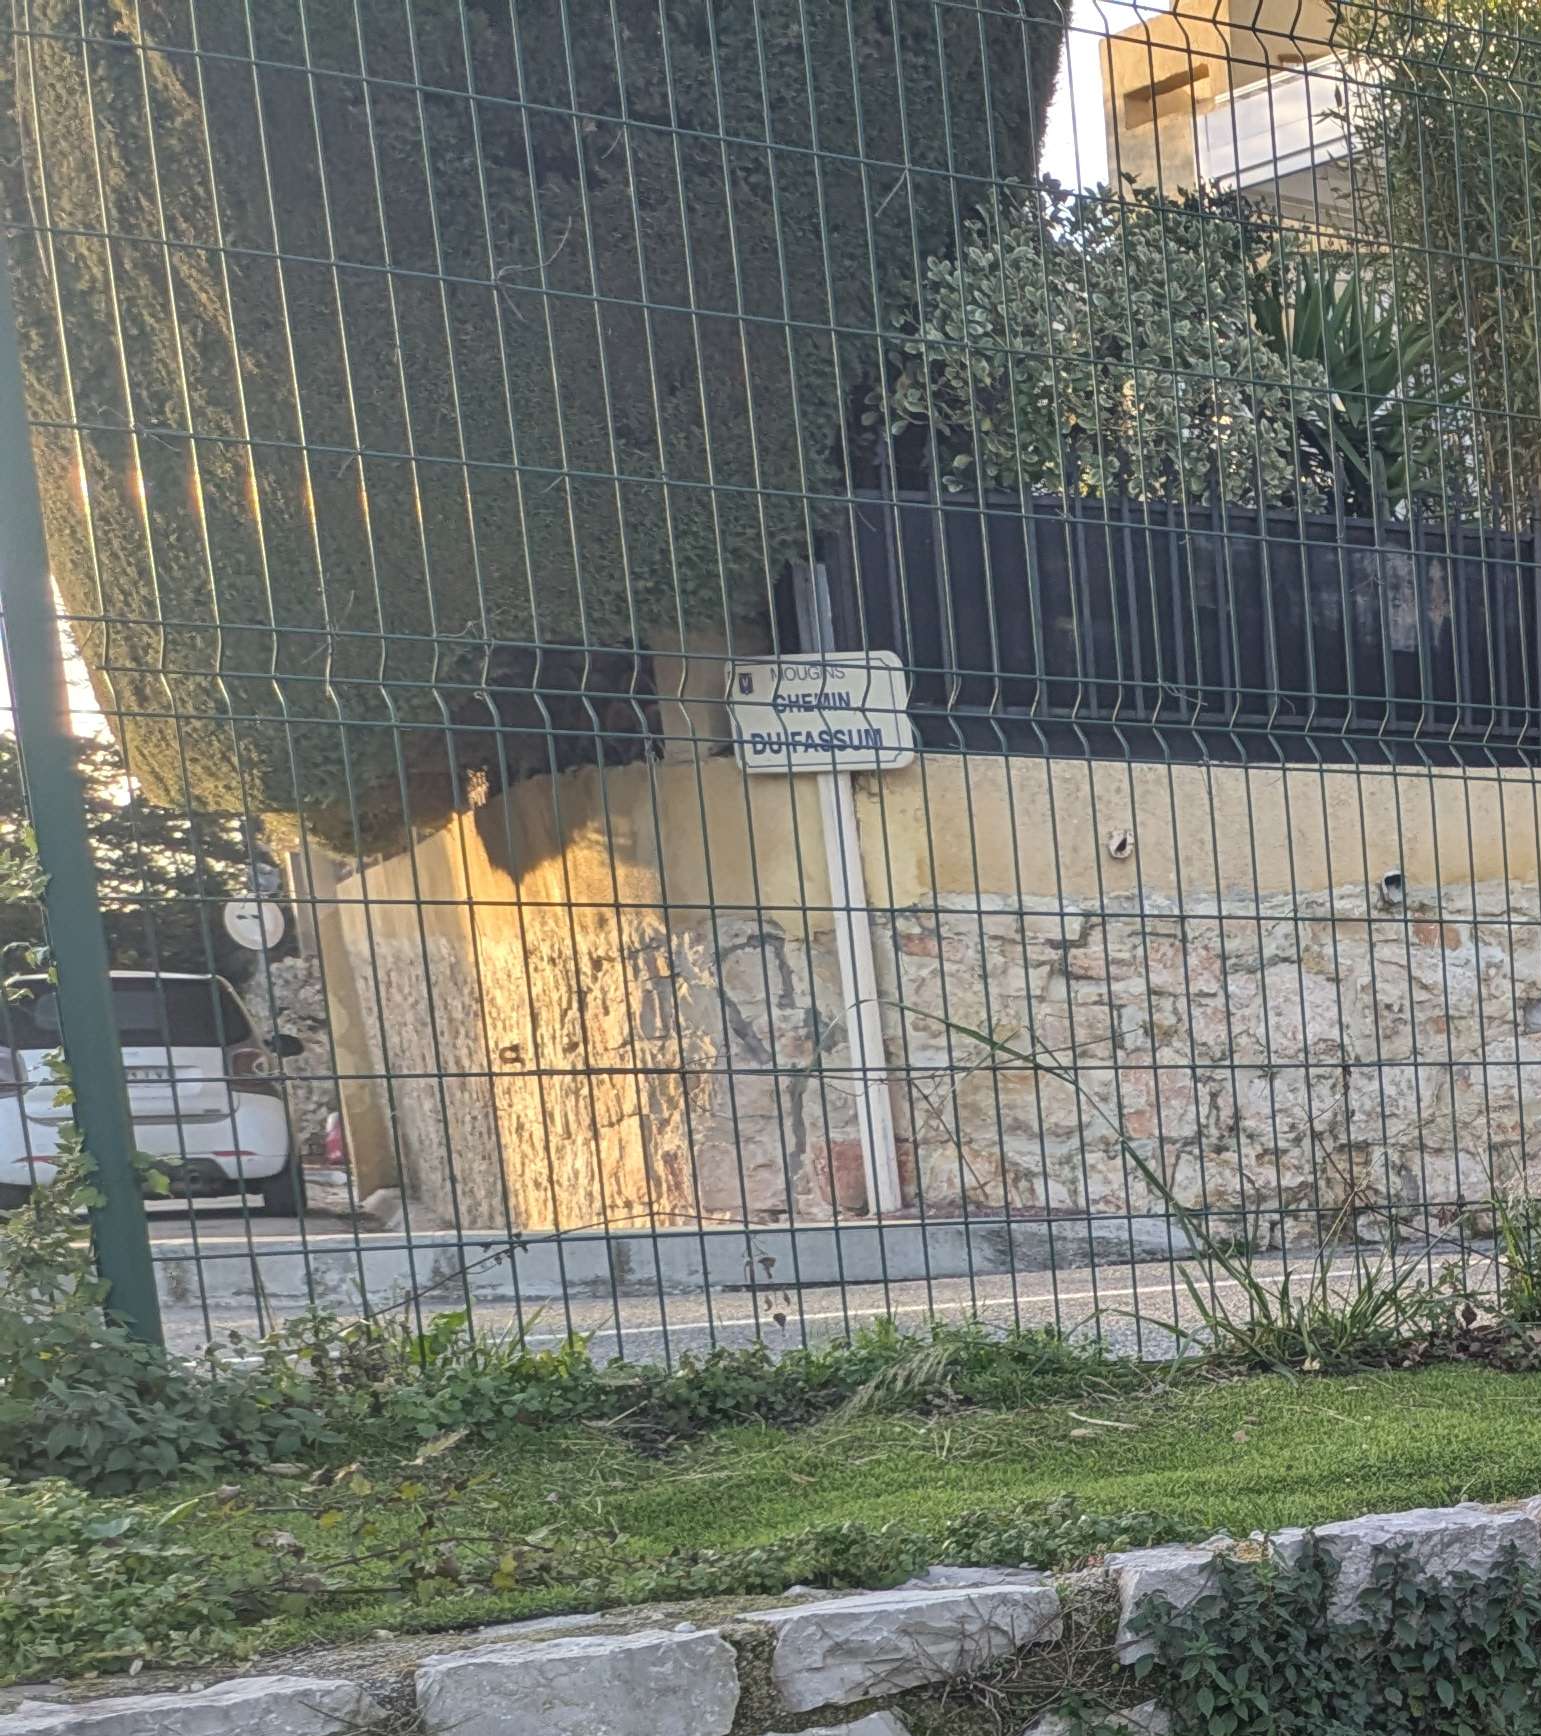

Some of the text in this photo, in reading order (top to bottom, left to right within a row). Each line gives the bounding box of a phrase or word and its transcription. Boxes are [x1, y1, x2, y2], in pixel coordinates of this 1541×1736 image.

[770, 666, 846, 681] MOUGNS
[773, 691, 851, 713] CHEMIN
[751, 732, 782, 755] DU
